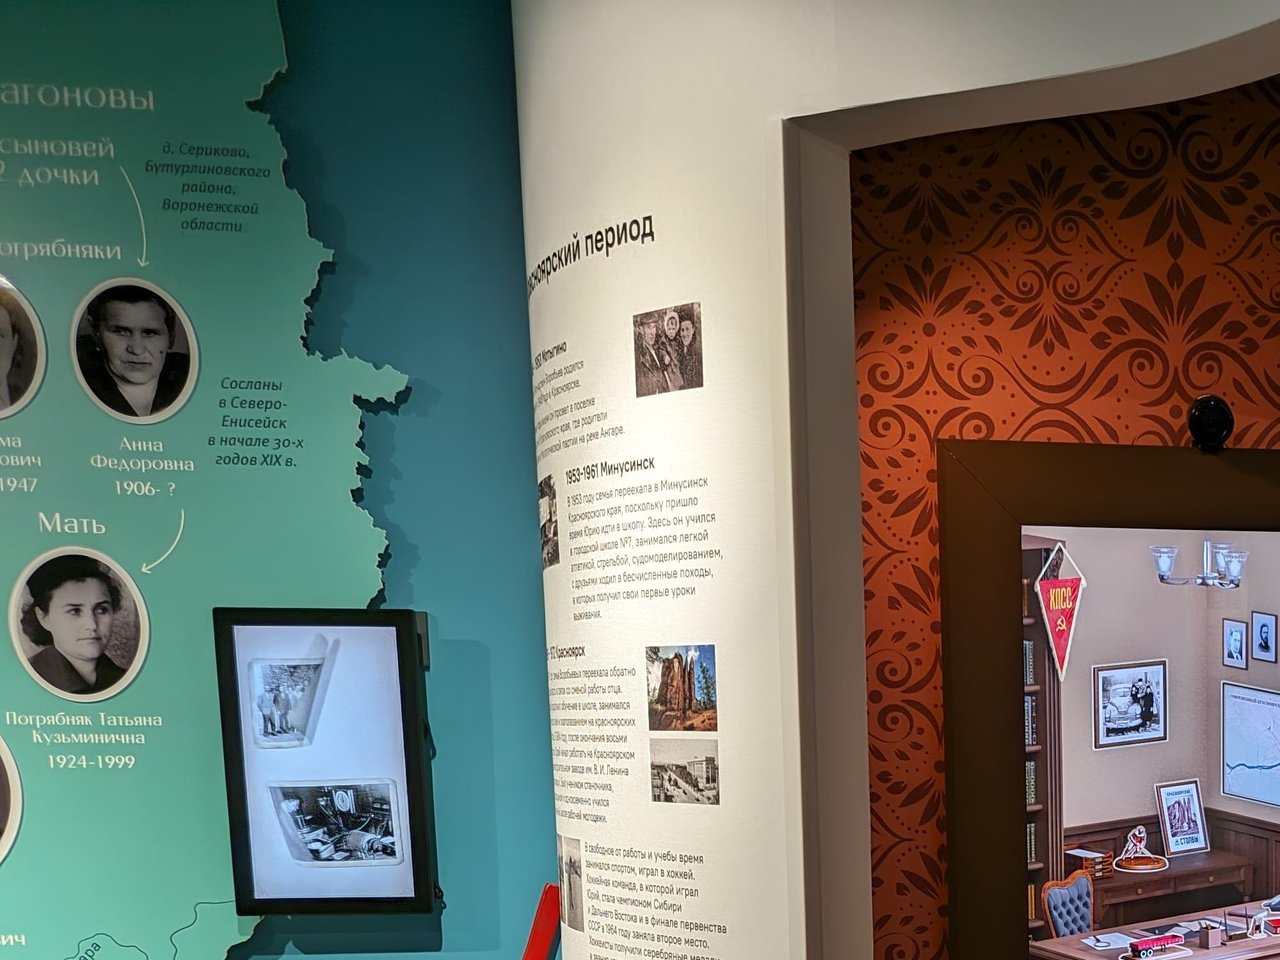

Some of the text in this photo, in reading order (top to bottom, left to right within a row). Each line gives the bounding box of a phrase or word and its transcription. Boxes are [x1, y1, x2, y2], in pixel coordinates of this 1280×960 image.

[162, 141, 174, 154] д.
[145, 160, 270, 177] Бутурлиновского
[18, 168, 98, 186] дочки
[162, 198, 258, 214] Воронежской
[181, 218, 242, 232] области
[584, 214, 654, 257] период
[221, 377, 282, 390] Сосланы
[218, 396, 287, 412] в Северо-
[221, 415, 287, 429] Енисейск
[599, 425, 626, 439] Ангаре.
[119, 436, 162, 452] Анна
[208, 436, 304, 450] в начале 30-х
[0, 455, 41, 466] ович
[90, 454, 194, 472] Федоровна
[215, 452, 296, 467] годов XIX в.
[564, 457, 655, 485] 1953-1961 Минусинск
[0, 477, 37, 492] 1947
[167, 482, 175, 496] ?
[594, 477, 708, 501] семья переехала в Минусинск
[624, 500, 663, 513] поскольку
[665, 497, 698, 510] пришло
[38, 512, 105, 534] Мать
[621, 521, 646, 531] школу.
[646, 516, 671, 528] Здесь
[672, 516, 683, 526] он
[684, 513, 716, 527] учился
[634, 529, 708, 547] занимался легкой
[596, 549, 723, 570] стрельбой, судомоделированием,
[622, 568, 713, 582] бесчисленные походы,
[621, 586, 696, 600] свои первые уроки
[1050, 587, 1072, 610] КПСС
[608, 666, 636, 677] обратно
[5, 711, 162, 728] Погрябняк Татьяна
[32, 730, 145, 745] Кузьминична
[48, 755, 135, 768] 1924-1999
[622, 847, 646, 859] работы
[647, 851, 652, 860] и
[653, 850, 677, 863] учебы
[637, 867, 658, 878] играл
[659, 869, 664, 877] в
[665, 869, 695, 880] хоккей.
[638, 883, 643, 891] в
[644, 884, 674, 896] которой
[675, 887, 698, 899] играл
[652, 898, 682, 914] Сибири
[649, 915, 678, 928] финале
[679, 920, 726, 934] первенства
[0, 934, 25, 945] ич
[656, 934, 682, 946] второе
[683, 938, 709, 949] место.
[613, 943, 642, 956] получили
